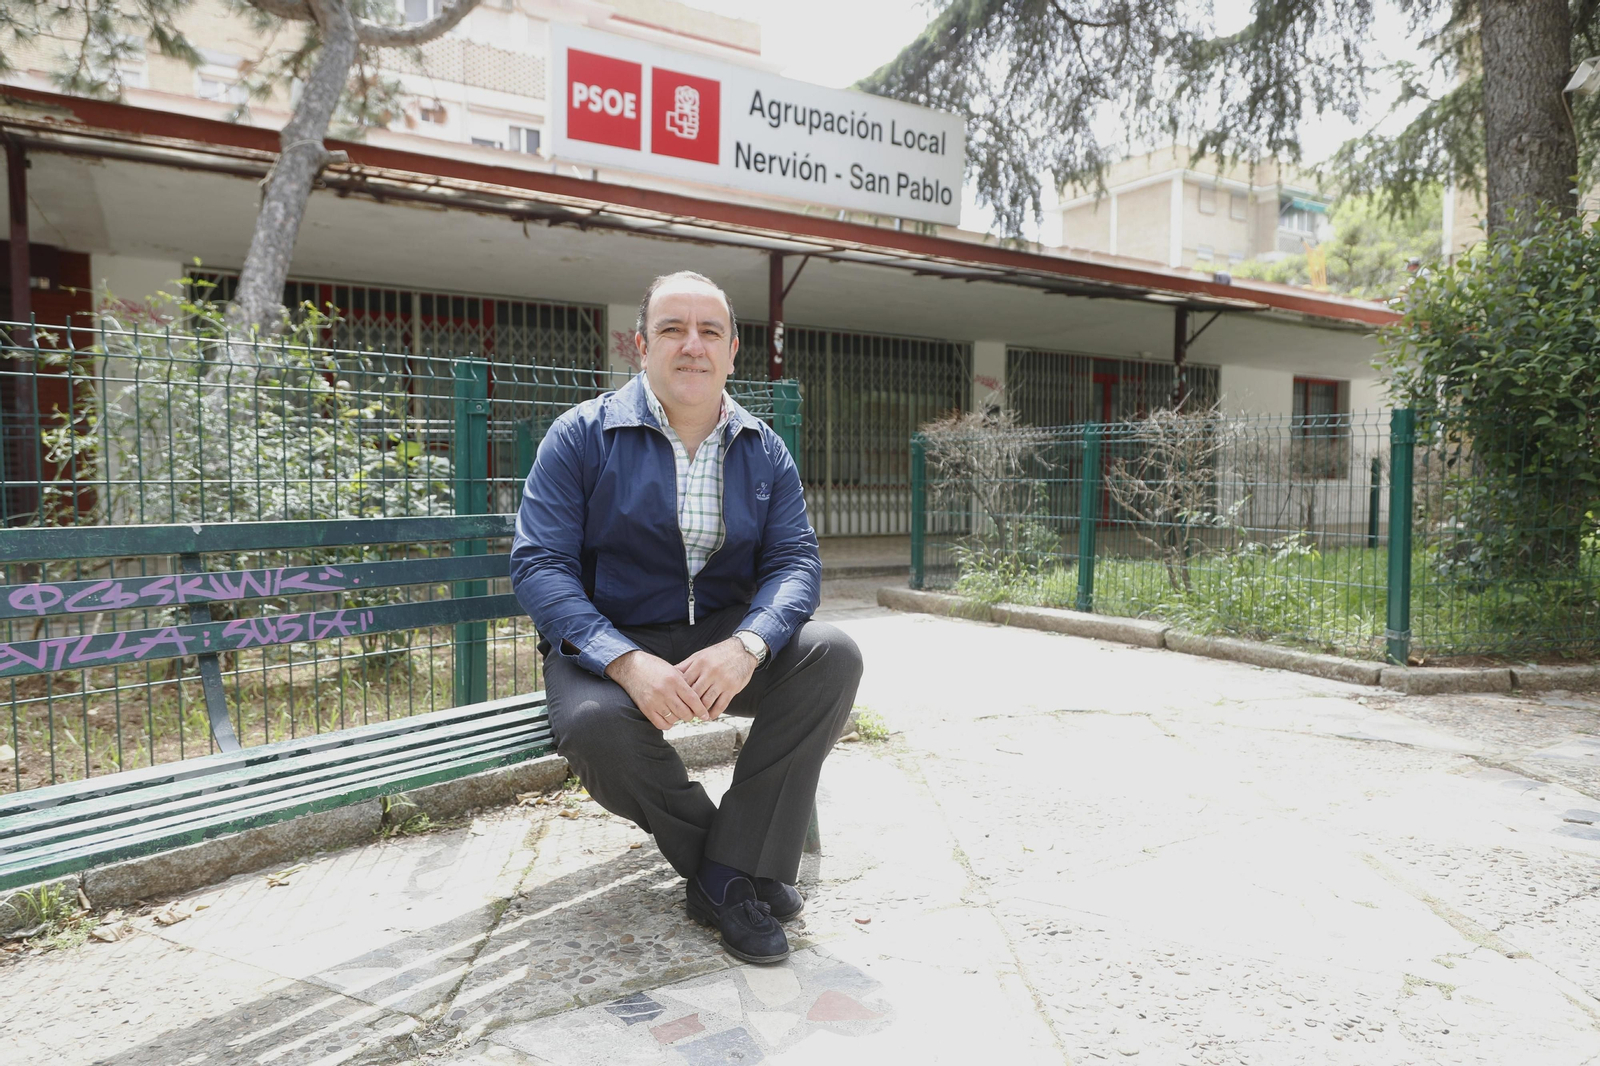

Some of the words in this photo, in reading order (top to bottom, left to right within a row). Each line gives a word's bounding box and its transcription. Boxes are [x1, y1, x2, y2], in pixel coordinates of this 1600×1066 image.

[572, 81, 637, 119] PSOE
[750, 90, 882, 143] Agrupación
[892, 120, 946, 155] Local
[736, 141, 828, 184] Nervión
[851, 164, 889, 195] San
[897, 172, 952, 206] Pablo
